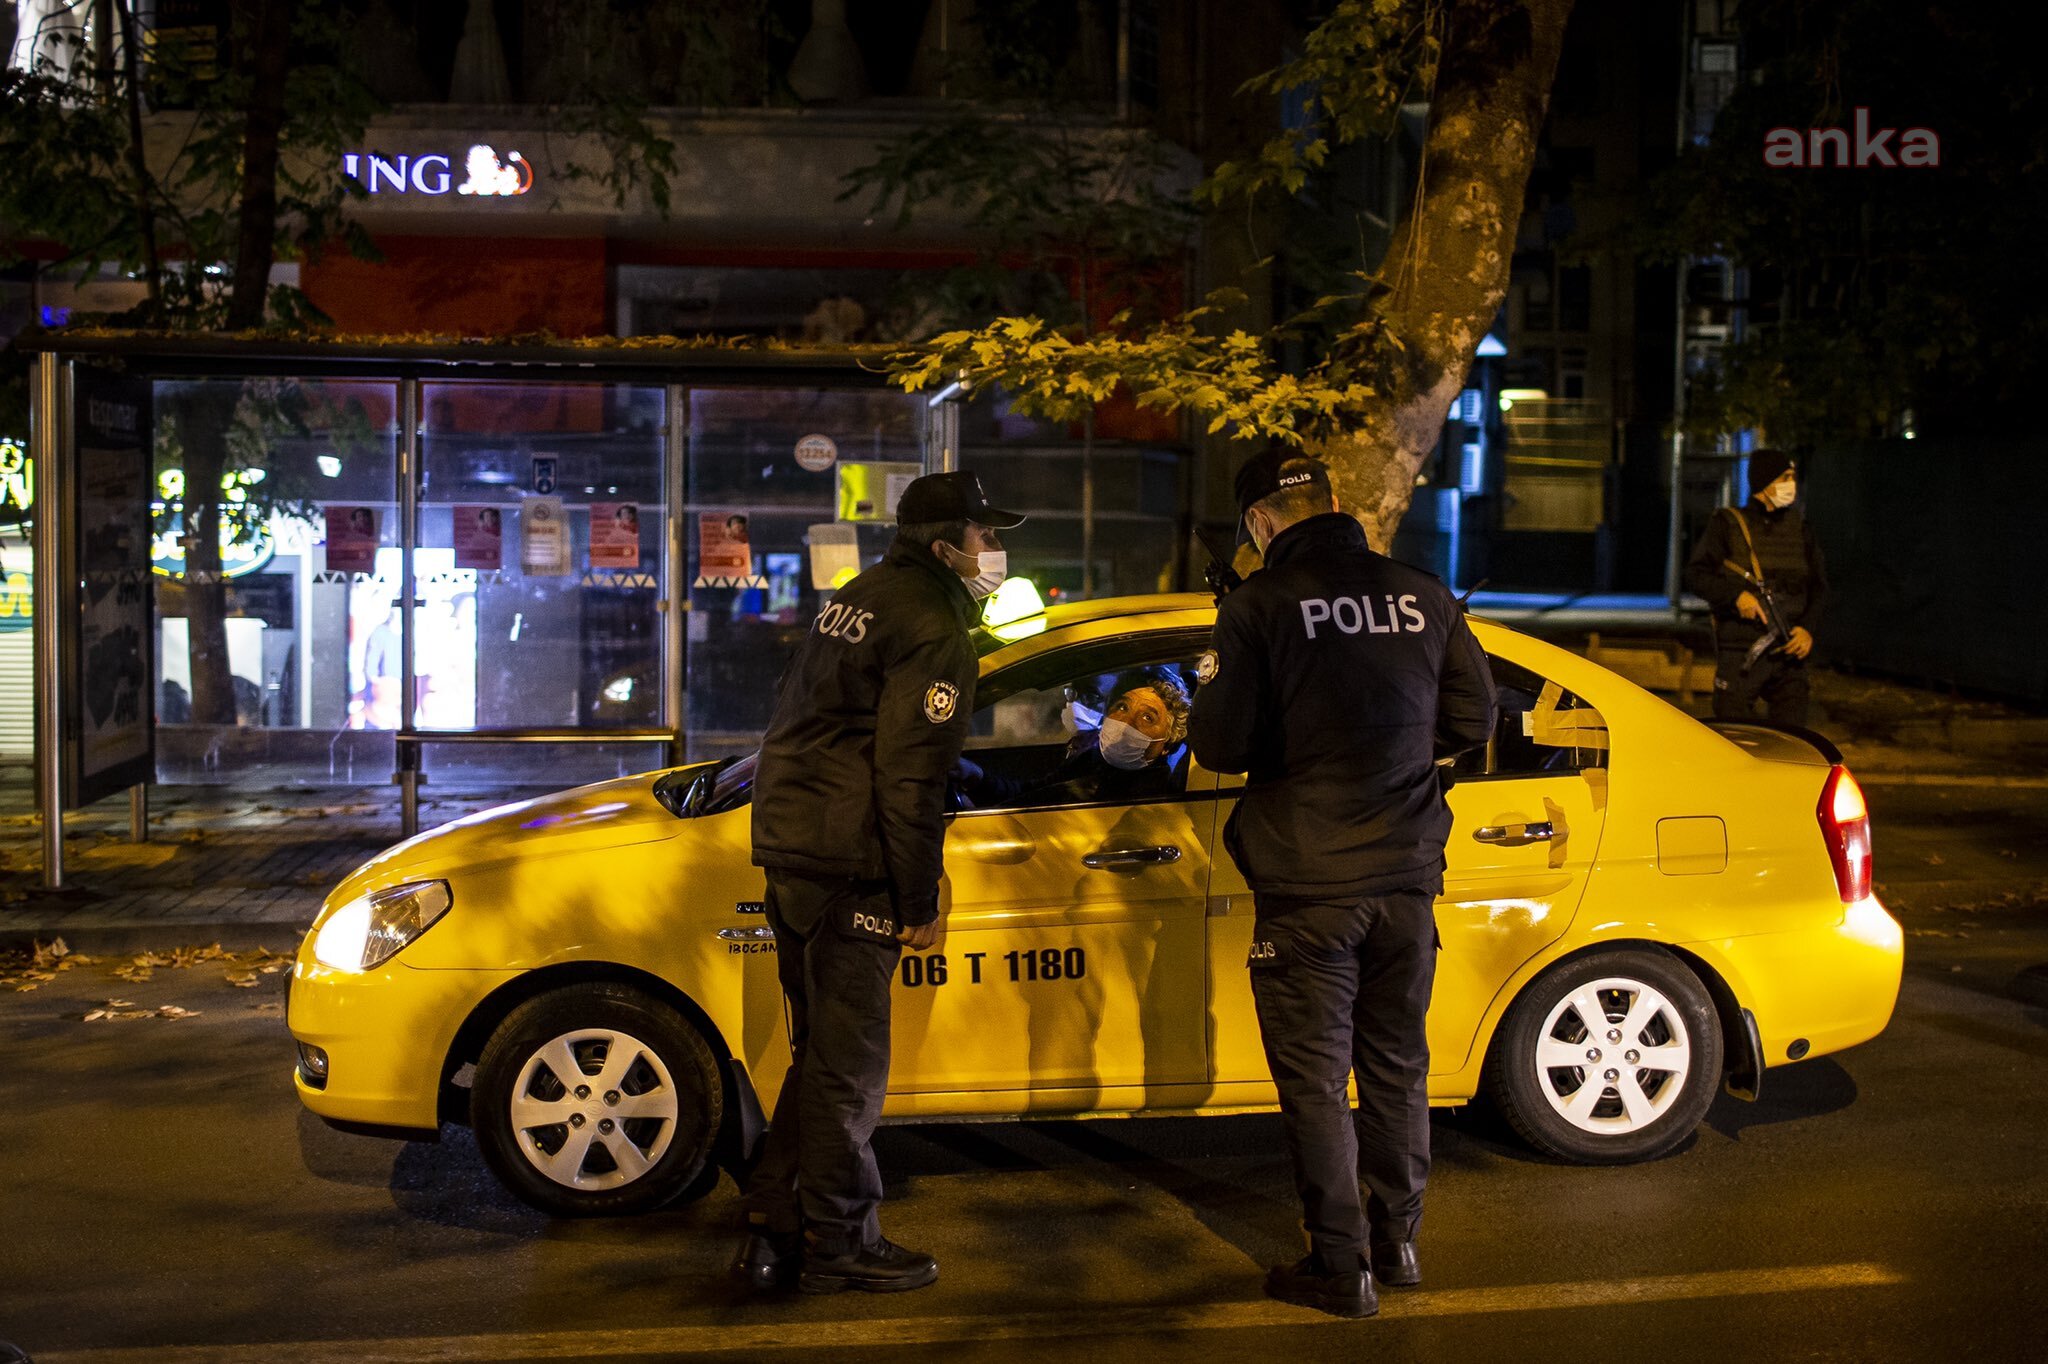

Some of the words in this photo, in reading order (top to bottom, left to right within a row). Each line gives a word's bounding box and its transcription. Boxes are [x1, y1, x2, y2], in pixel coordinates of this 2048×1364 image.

[343, 153, 452, 195] ING
[902, 955, 948, 987] 06
[964, 952, 987, 983] T
[1004, 947, 1085, 982] 1180
